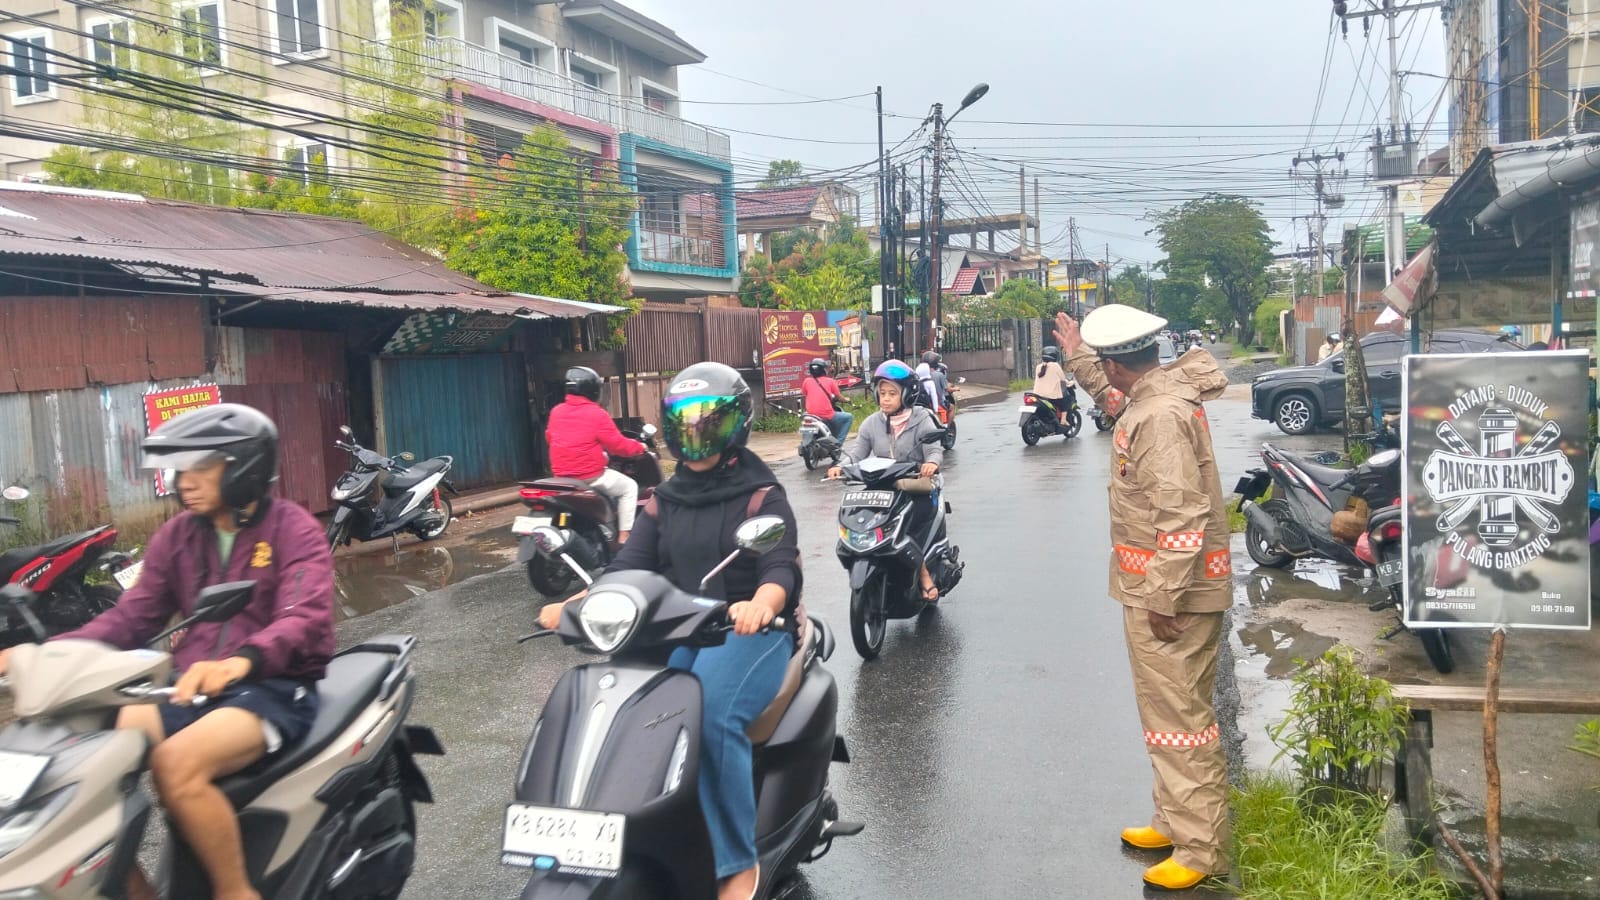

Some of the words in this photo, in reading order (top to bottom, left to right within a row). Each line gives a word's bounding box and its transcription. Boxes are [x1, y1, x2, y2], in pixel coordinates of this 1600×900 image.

[155, 396, 180, 409] KAMI
[182, 391, 211, 404] HAJAR
[161, 410, 172, 421] DI
[1448, 384, 1496, 420] DATANG
[1506, 385, 1550, 419] DUDUK
[1438, 457, 1499, 495] PANGKAS
[1502, 457, 1559, 495] RAMBUT
[1446, 530, 1494, 569] PULANG
[1495, 532, 1552, 570] GANTENG
